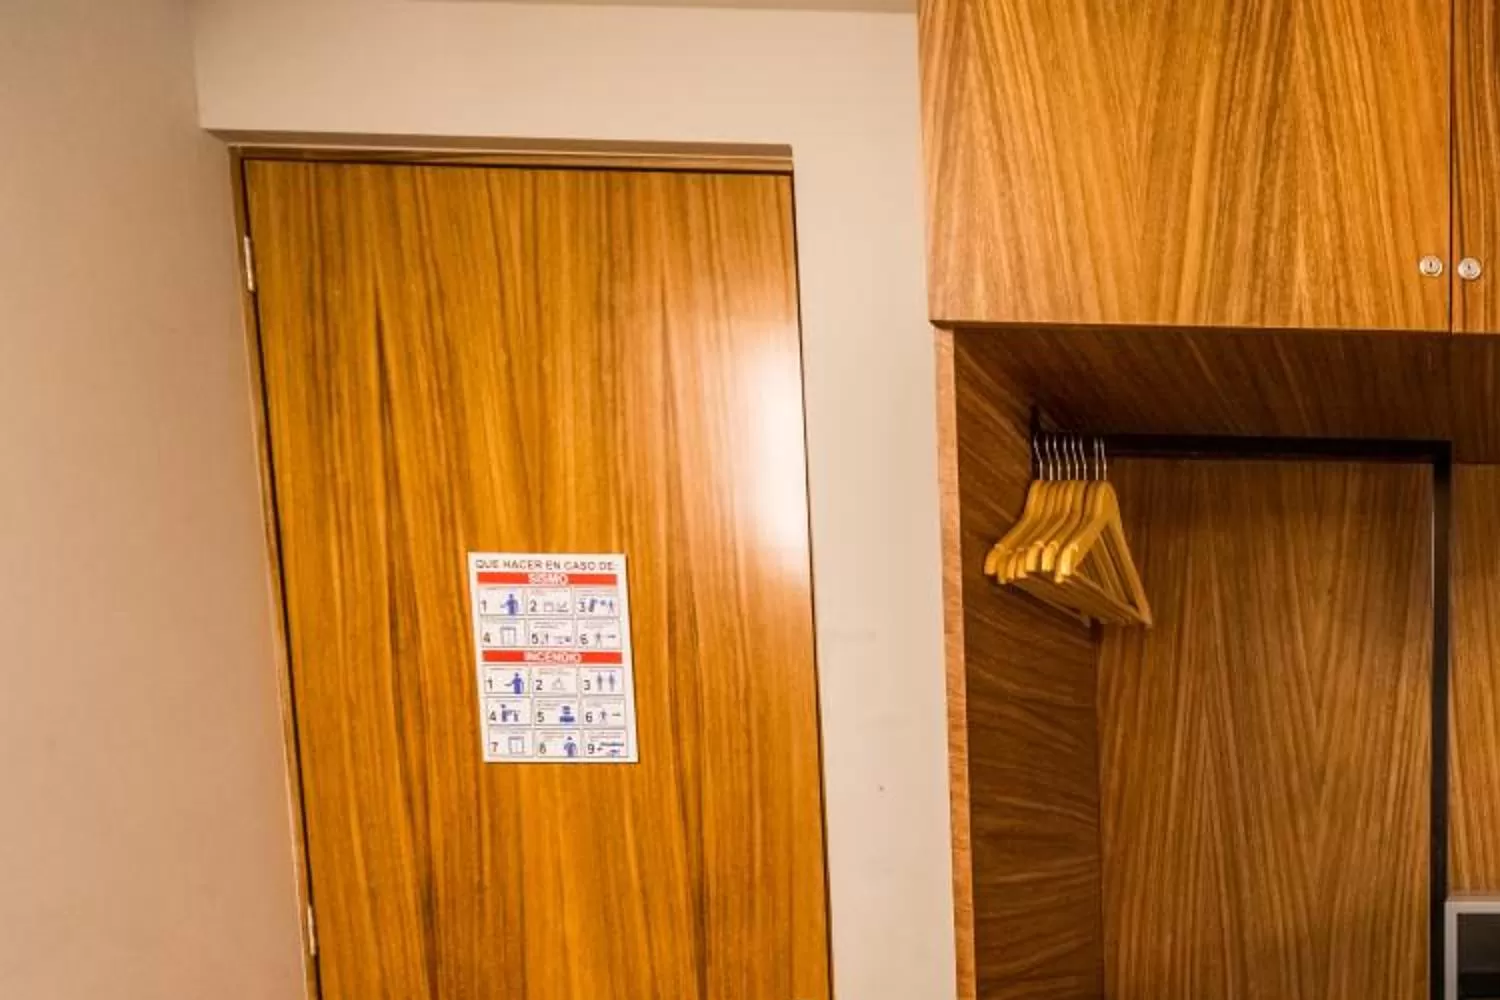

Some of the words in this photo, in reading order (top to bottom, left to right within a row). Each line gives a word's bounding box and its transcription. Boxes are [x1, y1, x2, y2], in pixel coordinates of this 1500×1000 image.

[475, 559, 499, 569] QUE
[503, 560, 543, 569] HACER
[546, 560, 560, 570] EN
[563, 560, 597, 570] CASO
